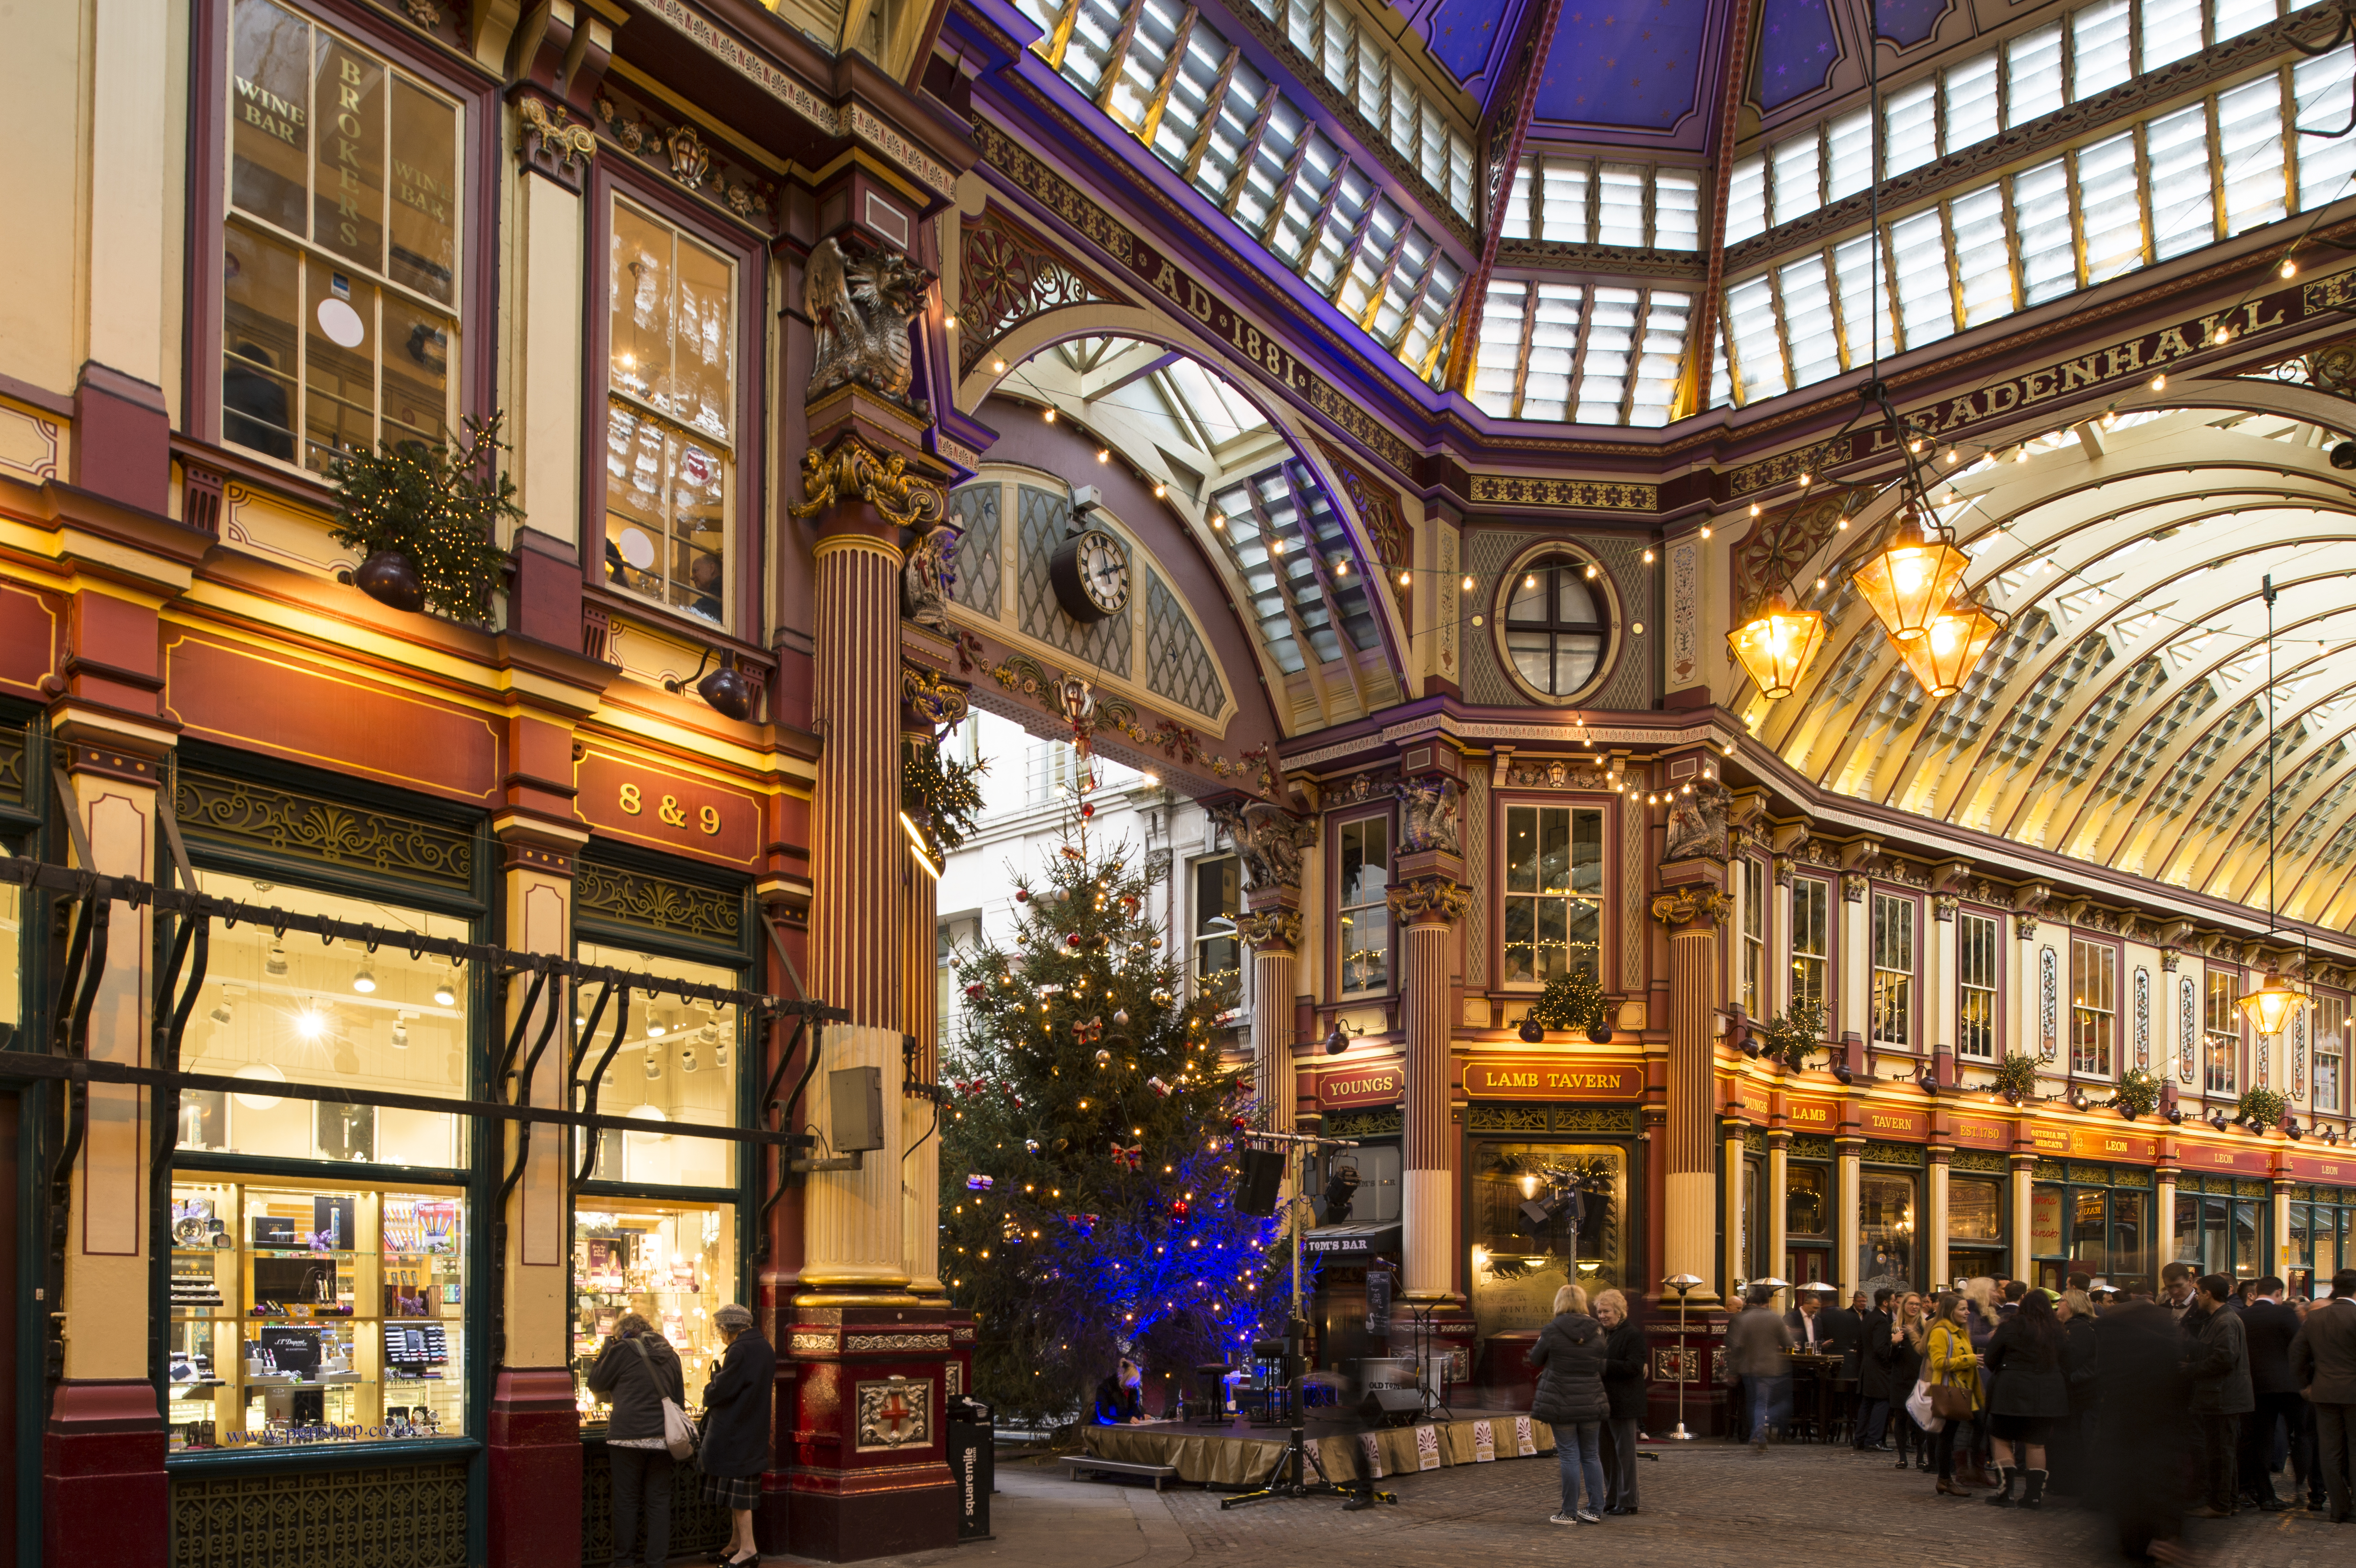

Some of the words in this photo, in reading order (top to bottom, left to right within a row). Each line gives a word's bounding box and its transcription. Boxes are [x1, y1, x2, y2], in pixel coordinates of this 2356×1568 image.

[234, 75, 305, 128] WINE
[244, 103, 295, 145] BAR
[338, 55, 362, 248] BROKERS
[393, 158, 453, 204] WINE
[400, 182, 444, 221] BAR
[1153, 259, 1212, 323] AD
[1232, 314, 1296, 390] 1881
[1870, 300, 2285, 453] LEADENHALL
[619, 783, 641, 814] 8
[658, 795, 686, 828] &
[699, 805, 720, 834] 9
[1330, 1077, 1394, 1097] YOUNGS
[1486, 1072, 1539, 1088] LAMB
[1548, 1074, 1621, 1089] TAVERN
[1792, 1107, 1827, 1122] LAMB
[1872, 1115, 1912, 1131] TAVERN
[1960, 1125, 1979, 1138] EST.
[1980, 1127, 2000, 1140] 1780
[2031, 1129, 2056, 1140] OSTERIA
[2057, 1132, 2068, 1140] DEL
[2035, 1139, 2063, 1149] MERCATO
[2075, 1137, 2083, 1148] 13
[2105, 1140, 2128, 1152] LEON
[2148, 1145, 2156, 1156] 13
[2175, 1148, 2181, 1159] 4
[2214, 1153, 2234, 1165] LEON
[2265, 1159, 2273, 1169] 14
[2289, 1162, 2293, 1170] 5
[2322, 1165, 2338, 1176] LEON
[2037, 1211, 2051, 1222] del
[1309, 1241, 1339, 1251] TOM'S
[1342, 1240, 1367, 1250] BAR
[226, 1419, 417, 1444] www.penshop.co.uk
[963, 1447, 975, 1516] squaremile
